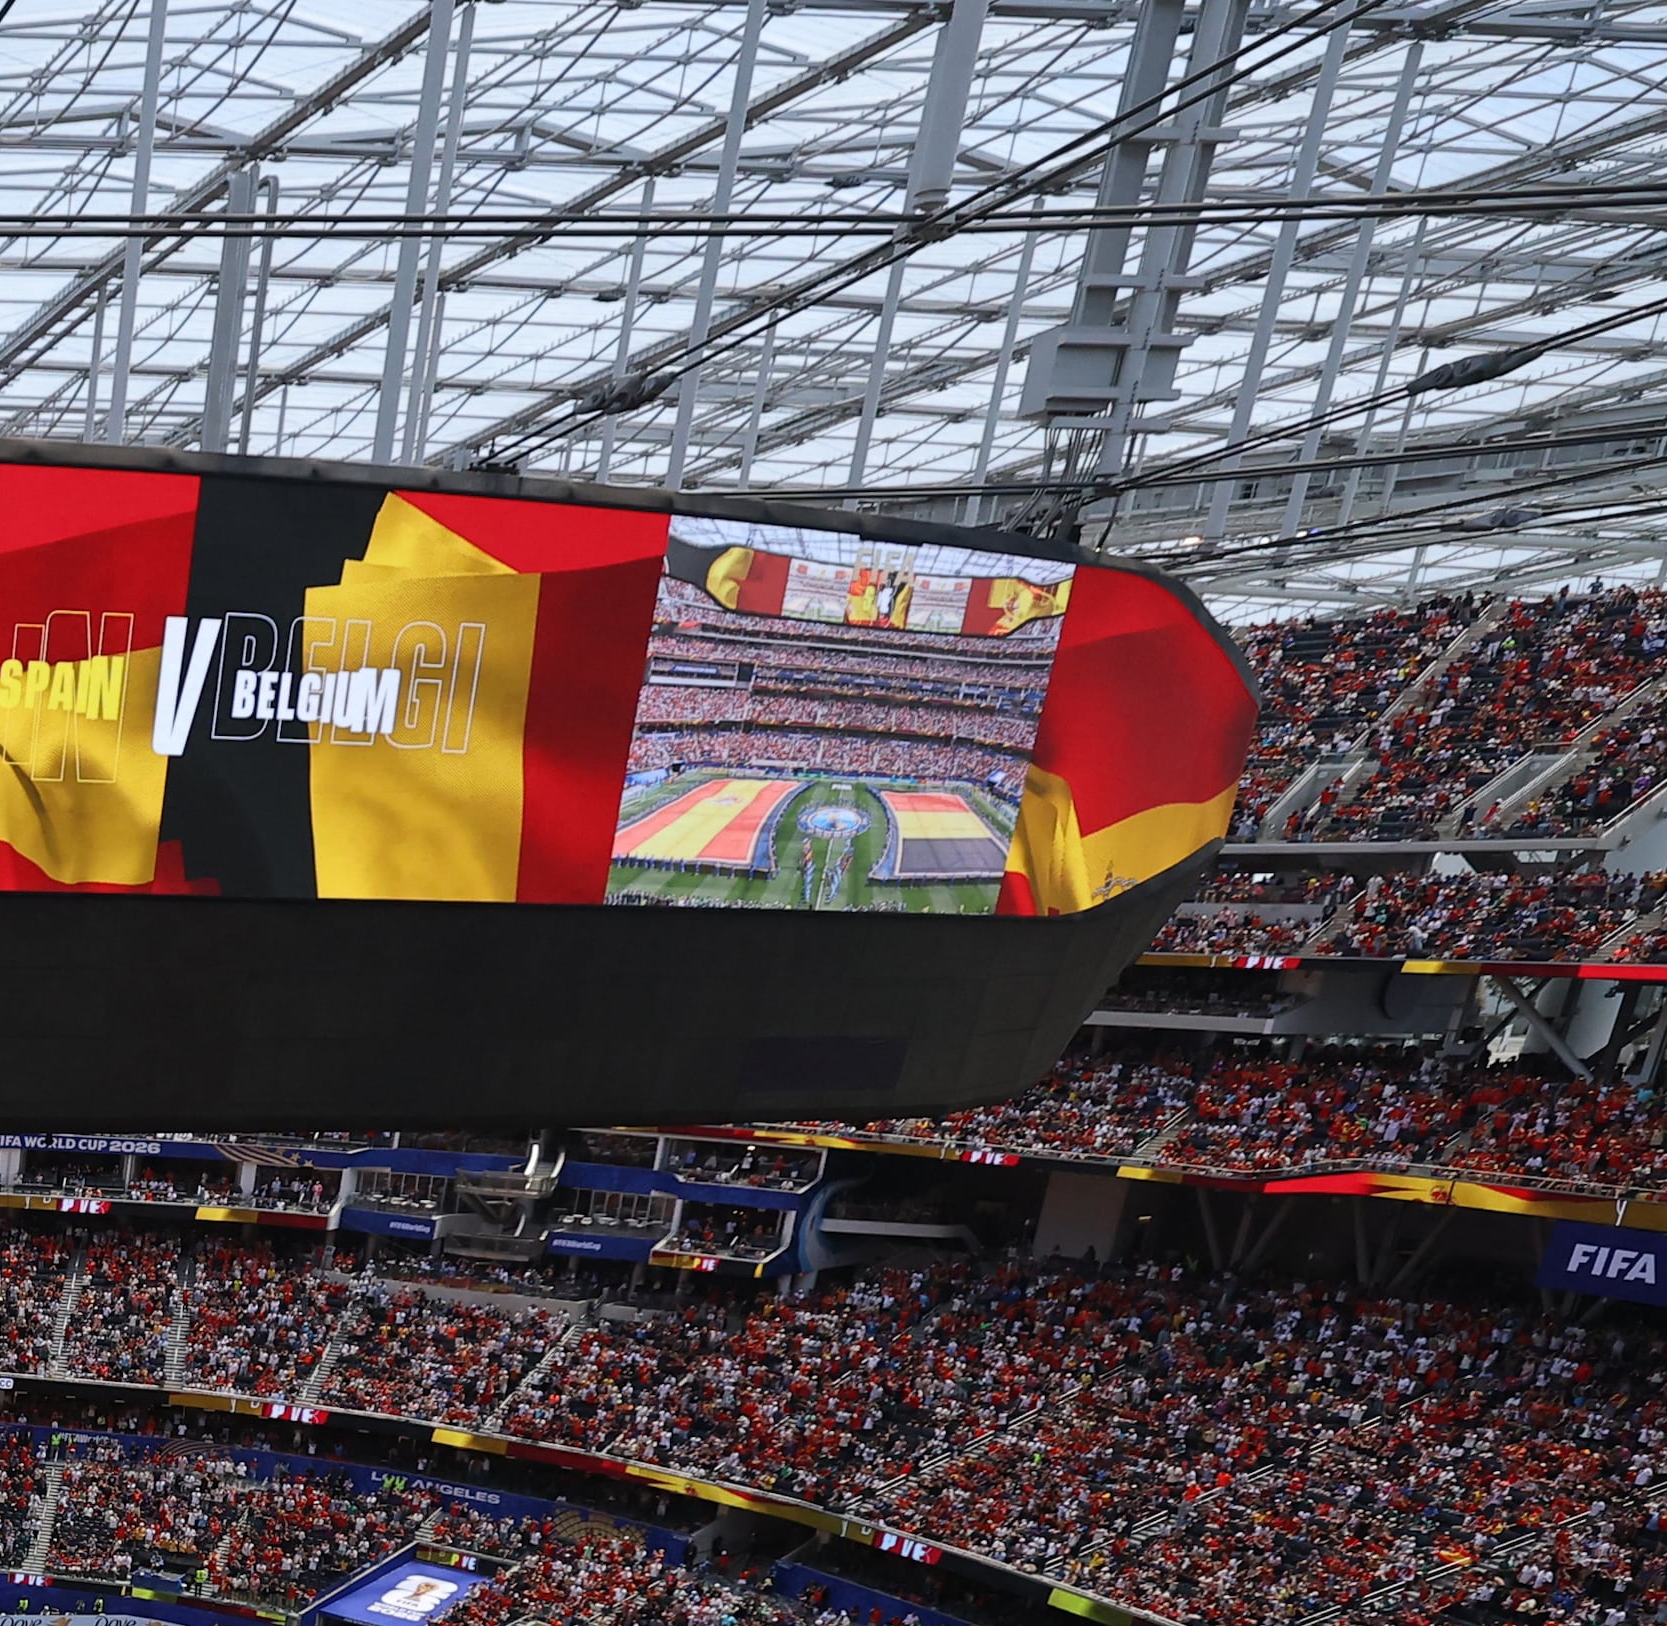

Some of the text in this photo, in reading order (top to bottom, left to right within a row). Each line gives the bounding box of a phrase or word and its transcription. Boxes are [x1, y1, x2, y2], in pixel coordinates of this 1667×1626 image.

[150, 614, 222, 757] V
[231, 666, 401, 735] BELGIUM
[77, 1138, 107, 1152] CUP
[108, 1140, 161, 1155] 2026
[1566, 1243, 1656, 1284] FIFA
